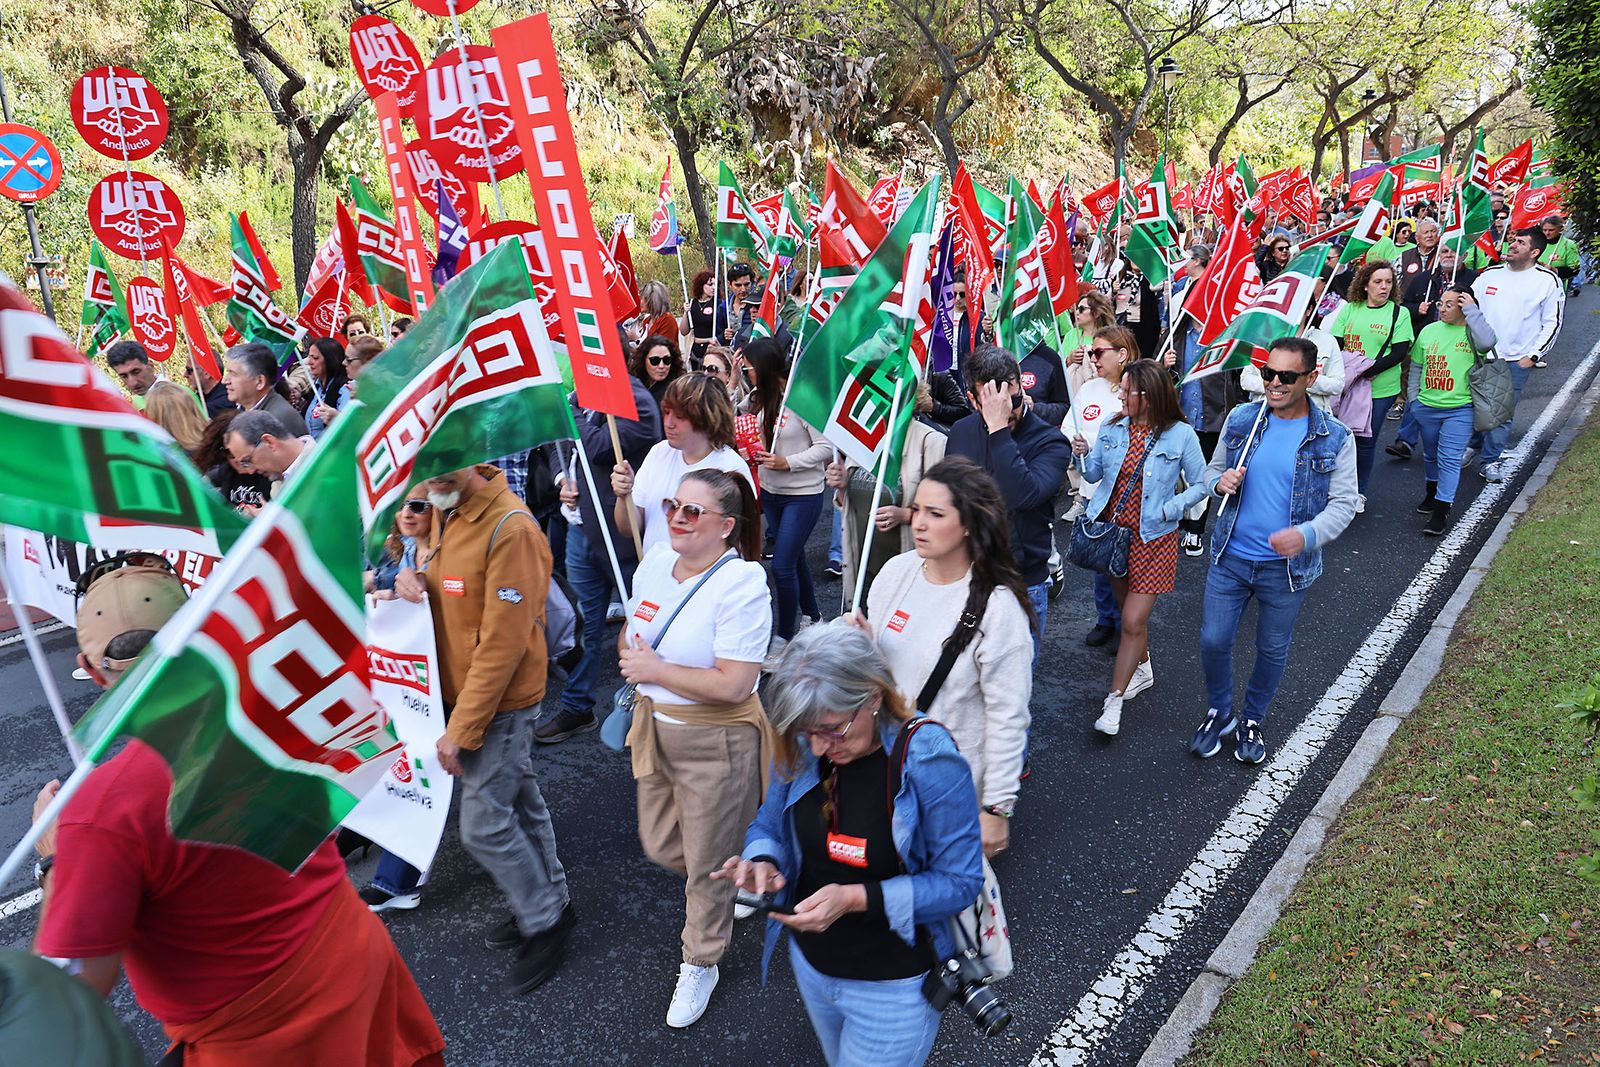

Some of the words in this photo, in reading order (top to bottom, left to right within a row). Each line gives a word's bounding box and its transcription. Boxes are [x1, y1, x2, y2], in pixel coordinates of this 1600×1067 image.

[351, 22, 409, 70] UGT
[83, 77, 150, 112] UGT
[425, 57, 509, 119] UGT
[101, 181, 167, 214] UGT
[130, 285, 167, 318] UGT
[1425, 377, 1454, 391] DIGNO
[384, 781, 432, 810] Huelva
